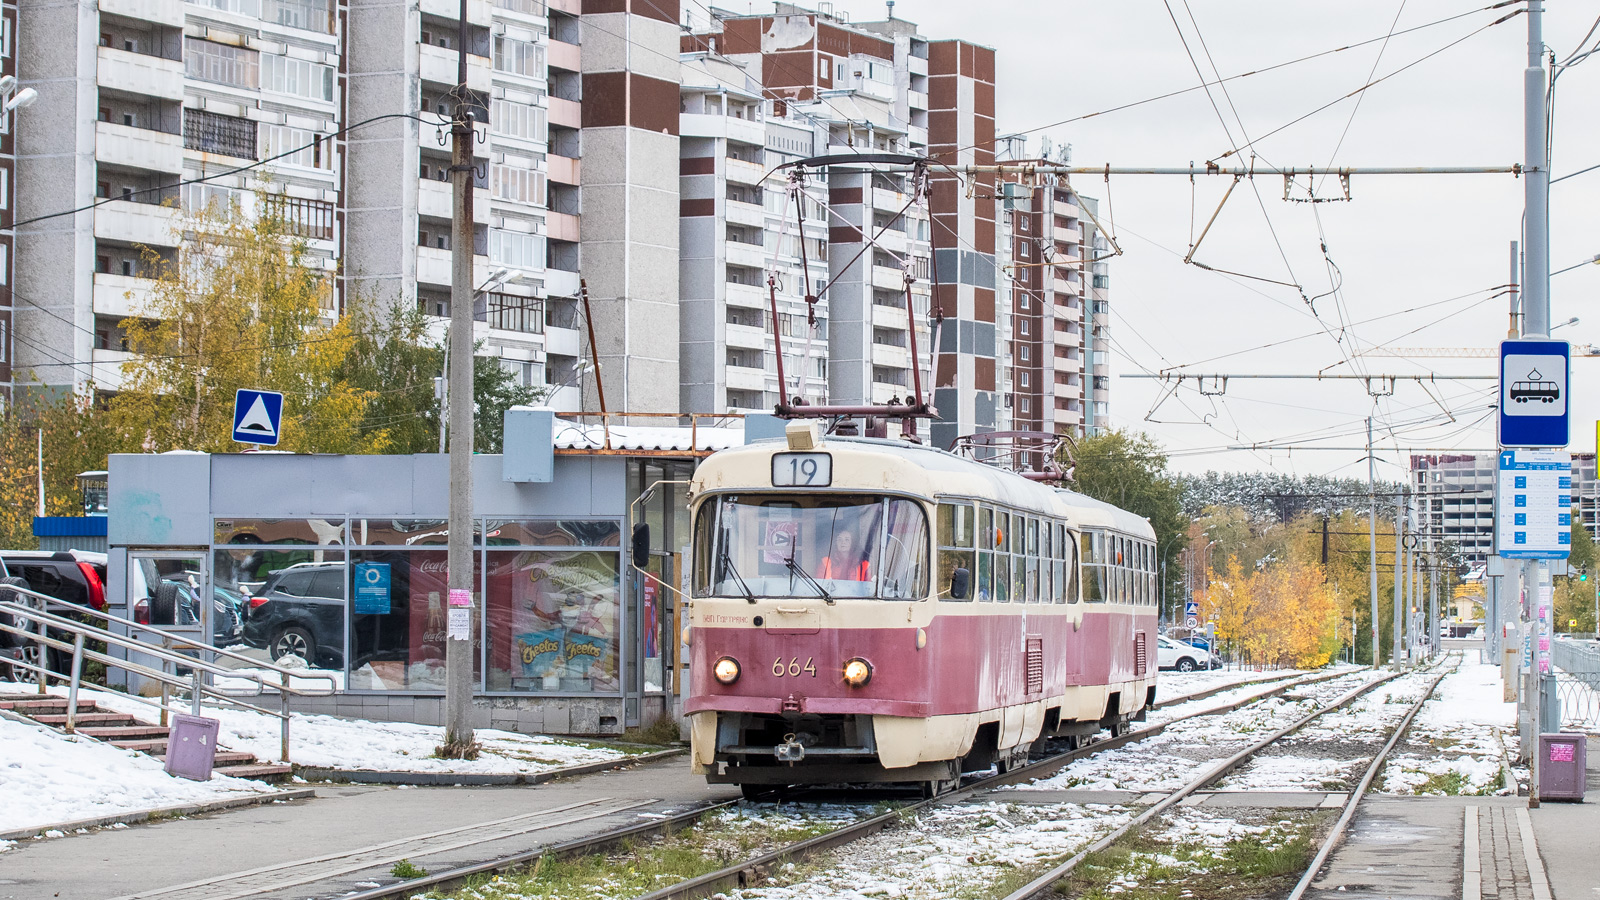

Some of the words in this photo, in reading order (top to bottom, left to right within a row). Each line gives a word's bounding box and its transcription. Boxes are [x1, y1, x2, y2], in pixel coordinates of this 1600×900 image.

[789, 458, 818, 485] 19
[522, 638, 560, 665] Cheetos
[772, 656, 817, 678] 664
